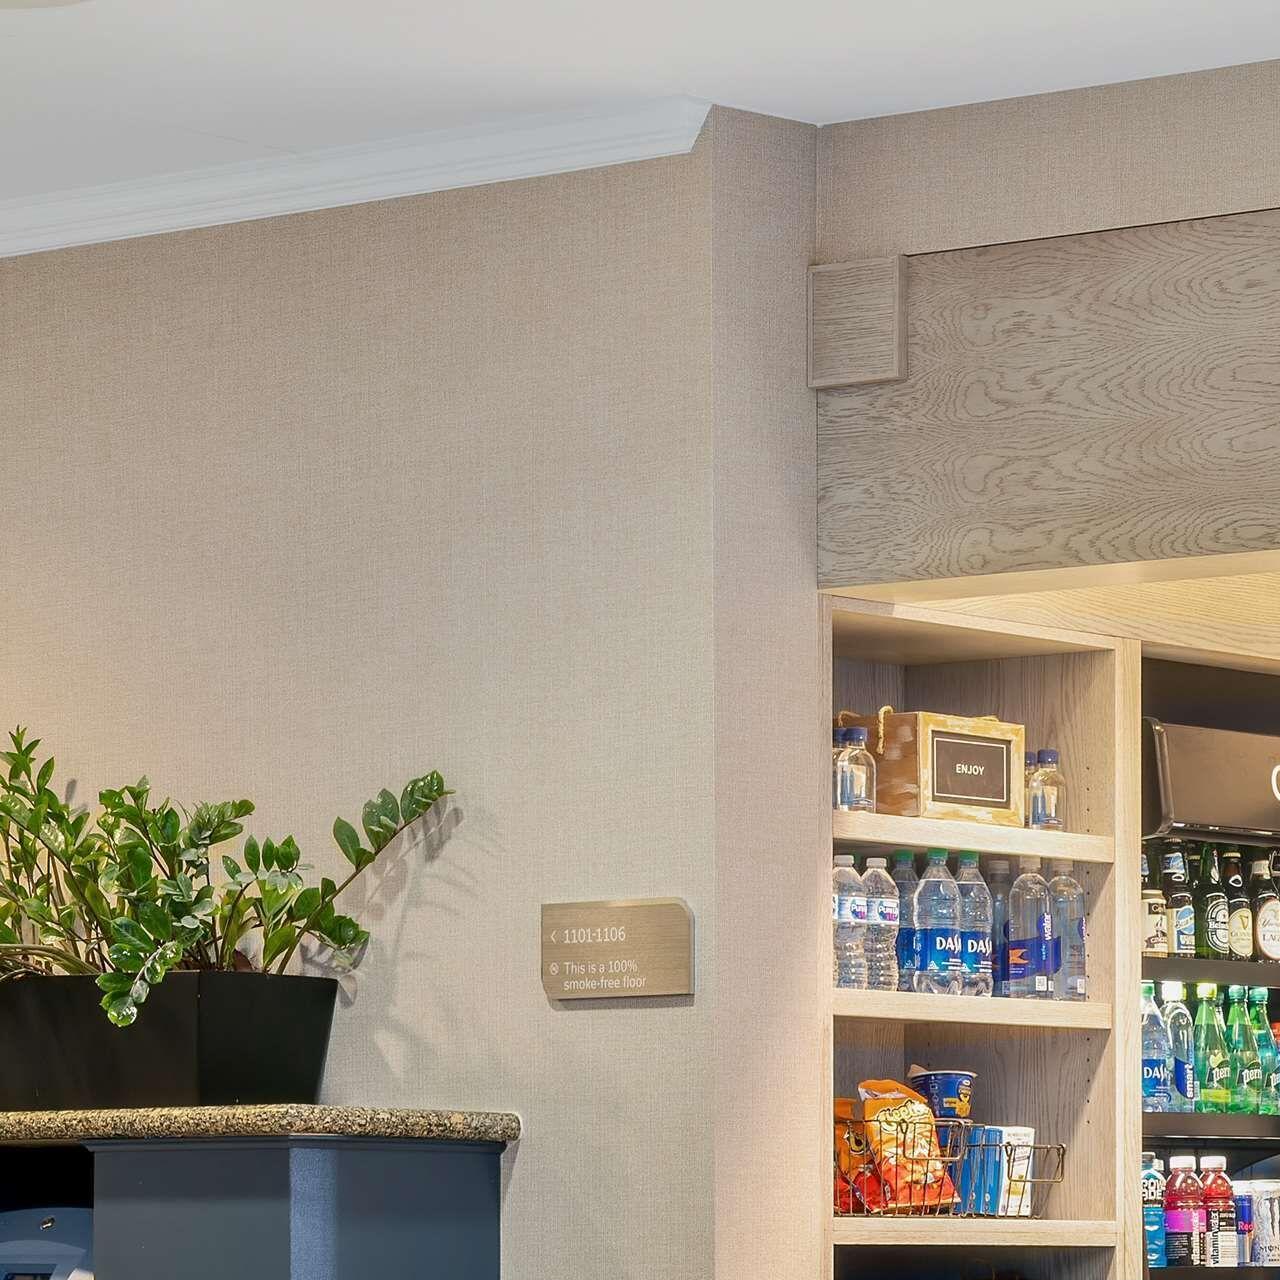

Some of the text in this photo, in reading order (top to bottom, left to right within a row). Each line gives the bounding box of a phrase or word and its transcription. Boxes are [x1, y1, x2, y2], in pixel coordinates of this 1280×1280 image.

[955, 764, 985, 776] ENJOY
[563, 926, 626, 944] 1101-1106
[564, 960, 638, 976] This is a 100%
[564, 976, 647, 991] smoke-free floor
